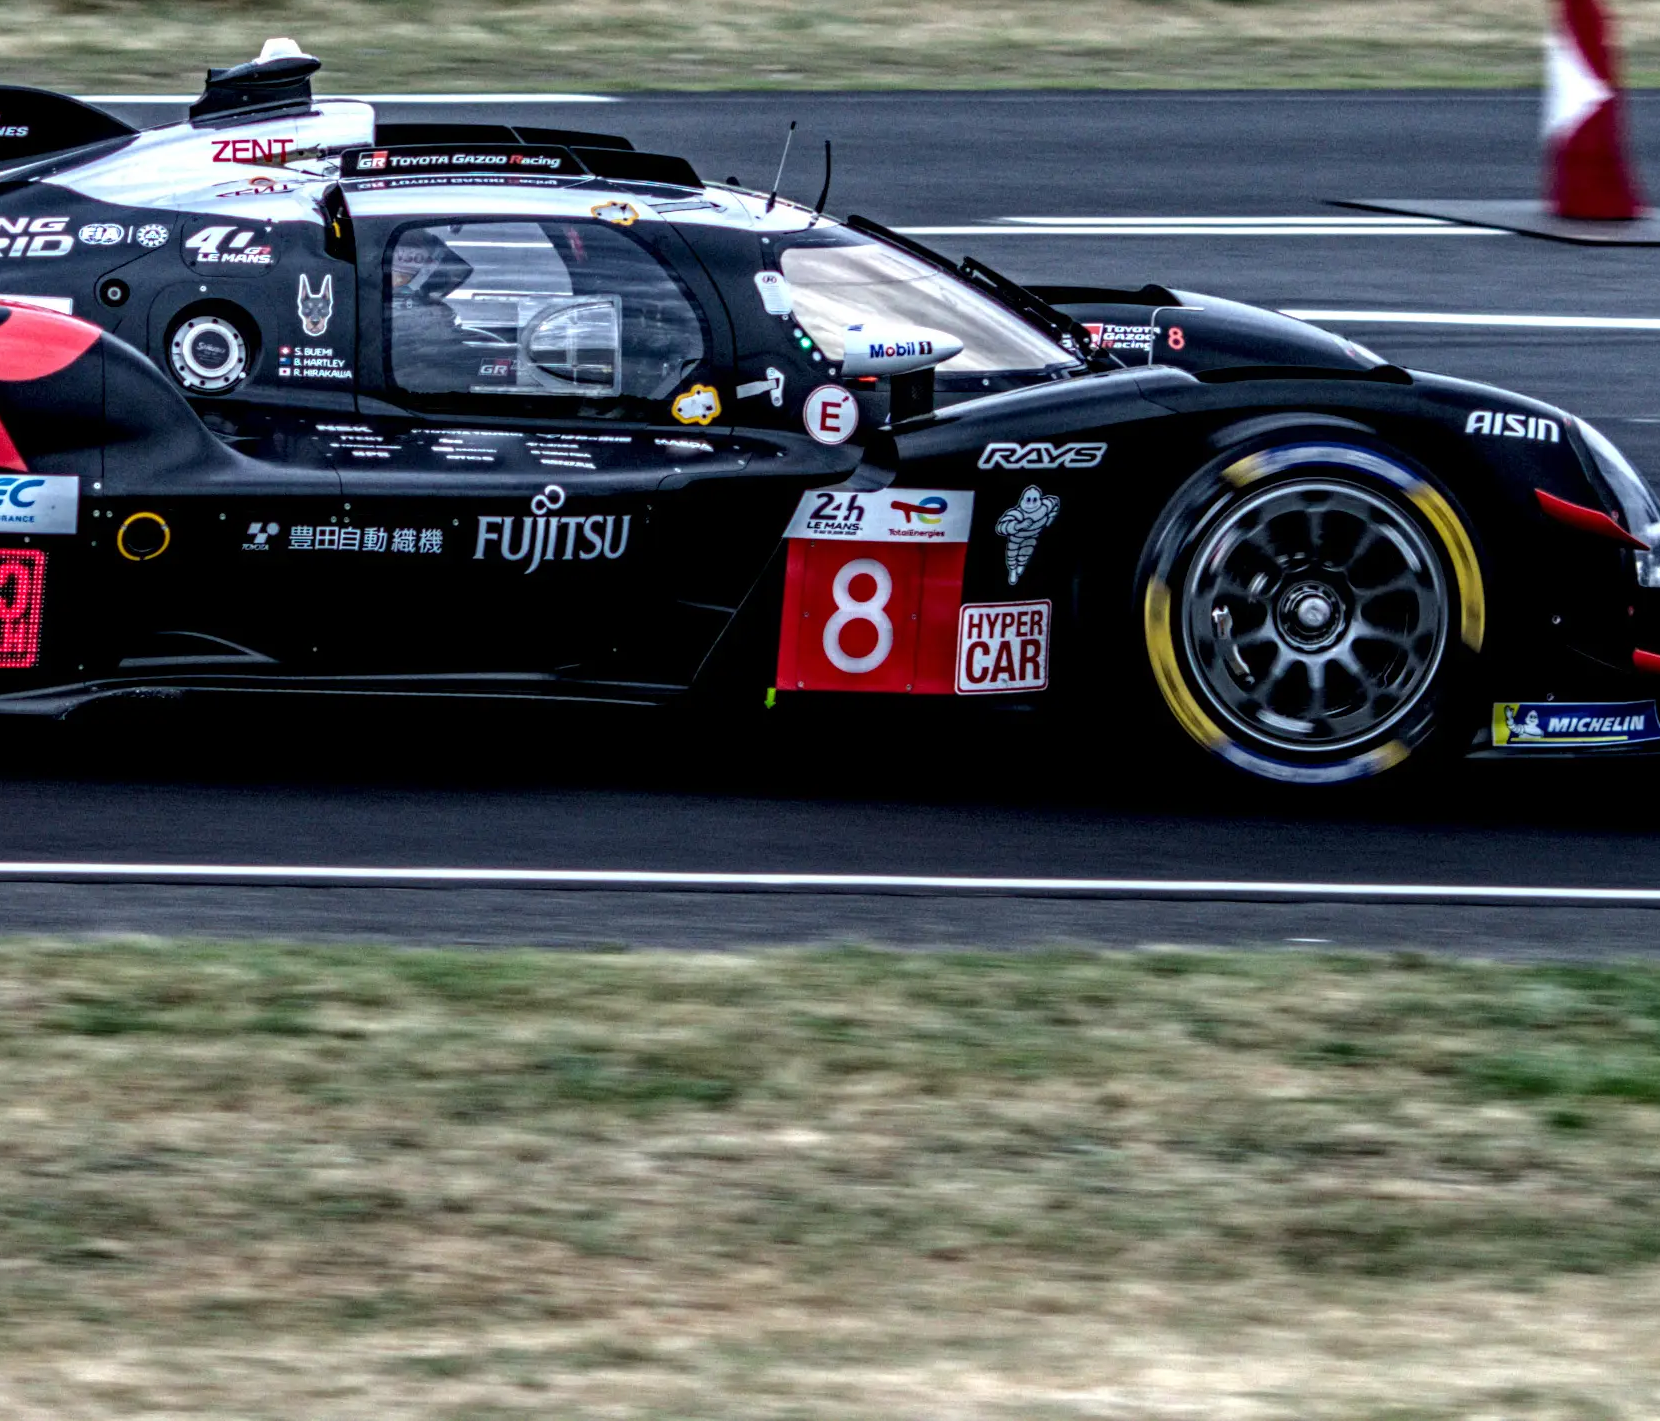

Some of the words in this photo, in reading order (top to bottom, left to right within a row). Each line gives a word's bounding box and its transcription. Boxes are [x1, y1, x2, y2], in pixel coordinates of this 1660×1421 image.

[211, 139, 294, 162] ZENT
[359, 158, 386, 168] GR
[390, 156, 448, 166] TOYOTA
[452, 154, 507, 165] GAZOO
[509, 155, 562, 168] Racing
[197, 253, 220, 262] LE
[221, 253, 271, 264] MANS
[1104, 324, 1161, 334] TOYOTA
[1168, 327, 1185, 350] 8
[304, 347, 333, 356] BUEMI
[869, 342, 916, 358] Mobil
[303, 358, 345, 368] HARTLEY
[480, 364, 507, 375] GR
[303, 368, 352, 378] HIRAKAWA
[1465, 411, 1559, 442] AISIN
[977, 442, 1107, 469] RAYS
[807, 521, 823, 529] LE
[824, 522, 860, 531] MANS
[889, 528, 945, 538] TotalEnergies
[288, 526, 444, 554] 豊田自動織機
[472, 515, 632, 574] FUJITSU
[822, 557, 894, 673] 8
[967, 610, 1043, 639] HYPER
[966, 639, 1041, 684] CAR
[1547, 715, 1645, 733] MICHELIN
